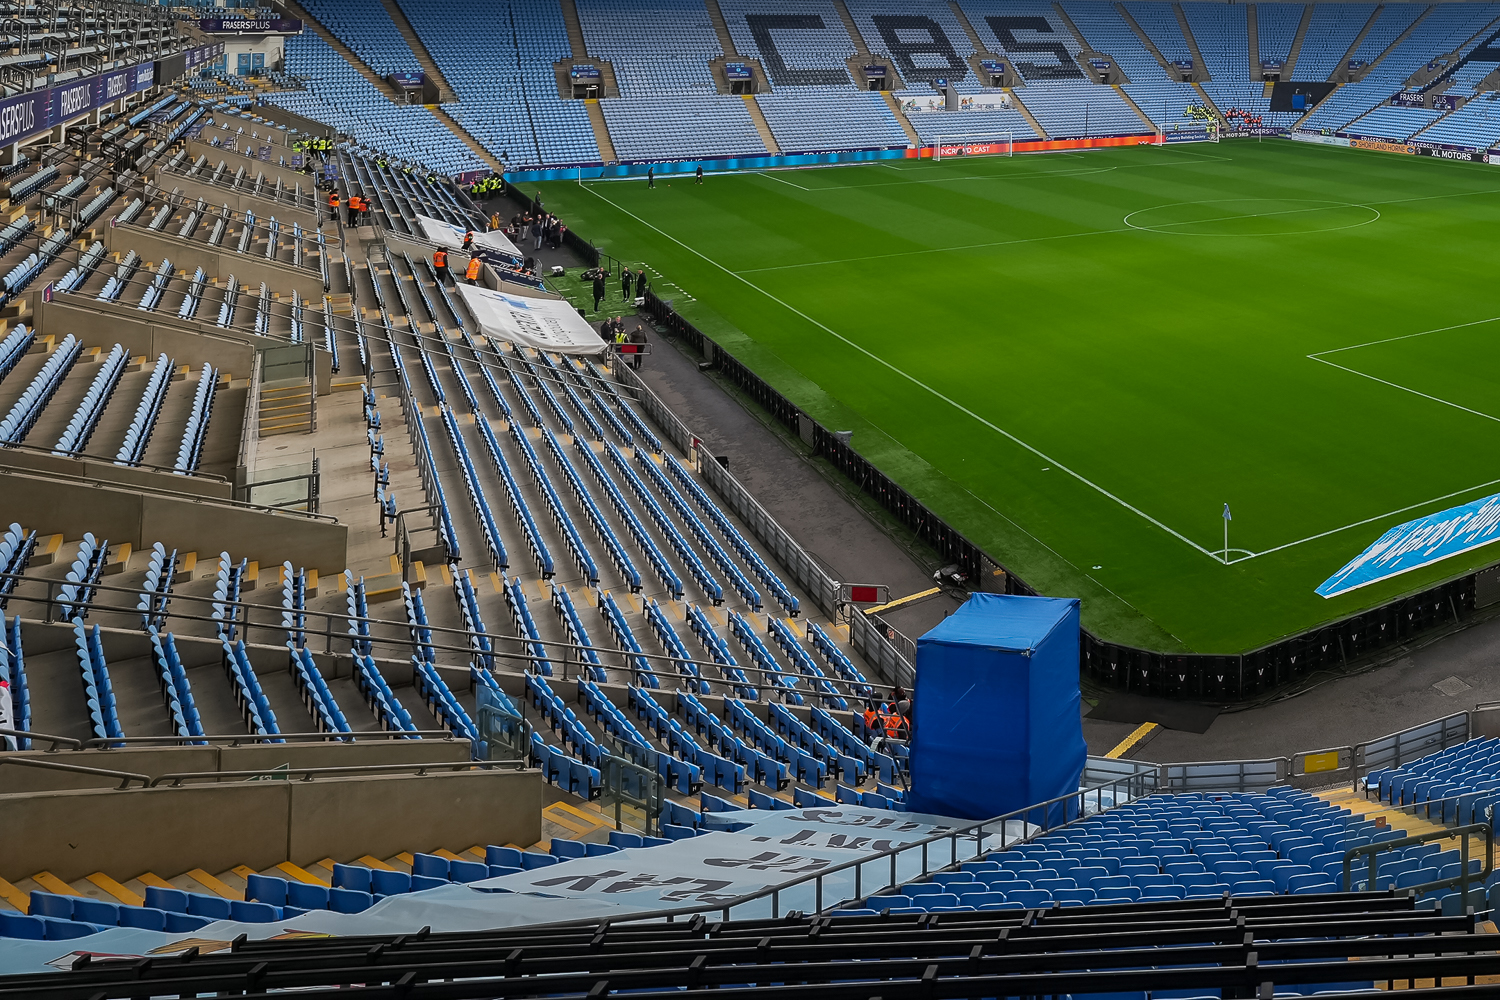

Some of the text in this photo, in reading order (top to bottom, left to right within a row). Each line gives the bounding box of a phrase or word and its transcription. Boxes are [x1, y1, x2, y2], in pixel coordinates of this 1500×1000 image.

[222, 20, 271, 31] FRASERSPLUS
[745, 13, 1085, 87] CBS
[61, 83, 91, 117] FRASERSPLUS
[1400, 93, 1447, 105] FRASERS PLUS
[0, 100, 35, 141] SERSPLUS
[1358, 140, 1386, 150] SHORTLAND
[1431, 150, 1472, 161] XL MOTORS
[1373, 512, 1473, 567] Society
